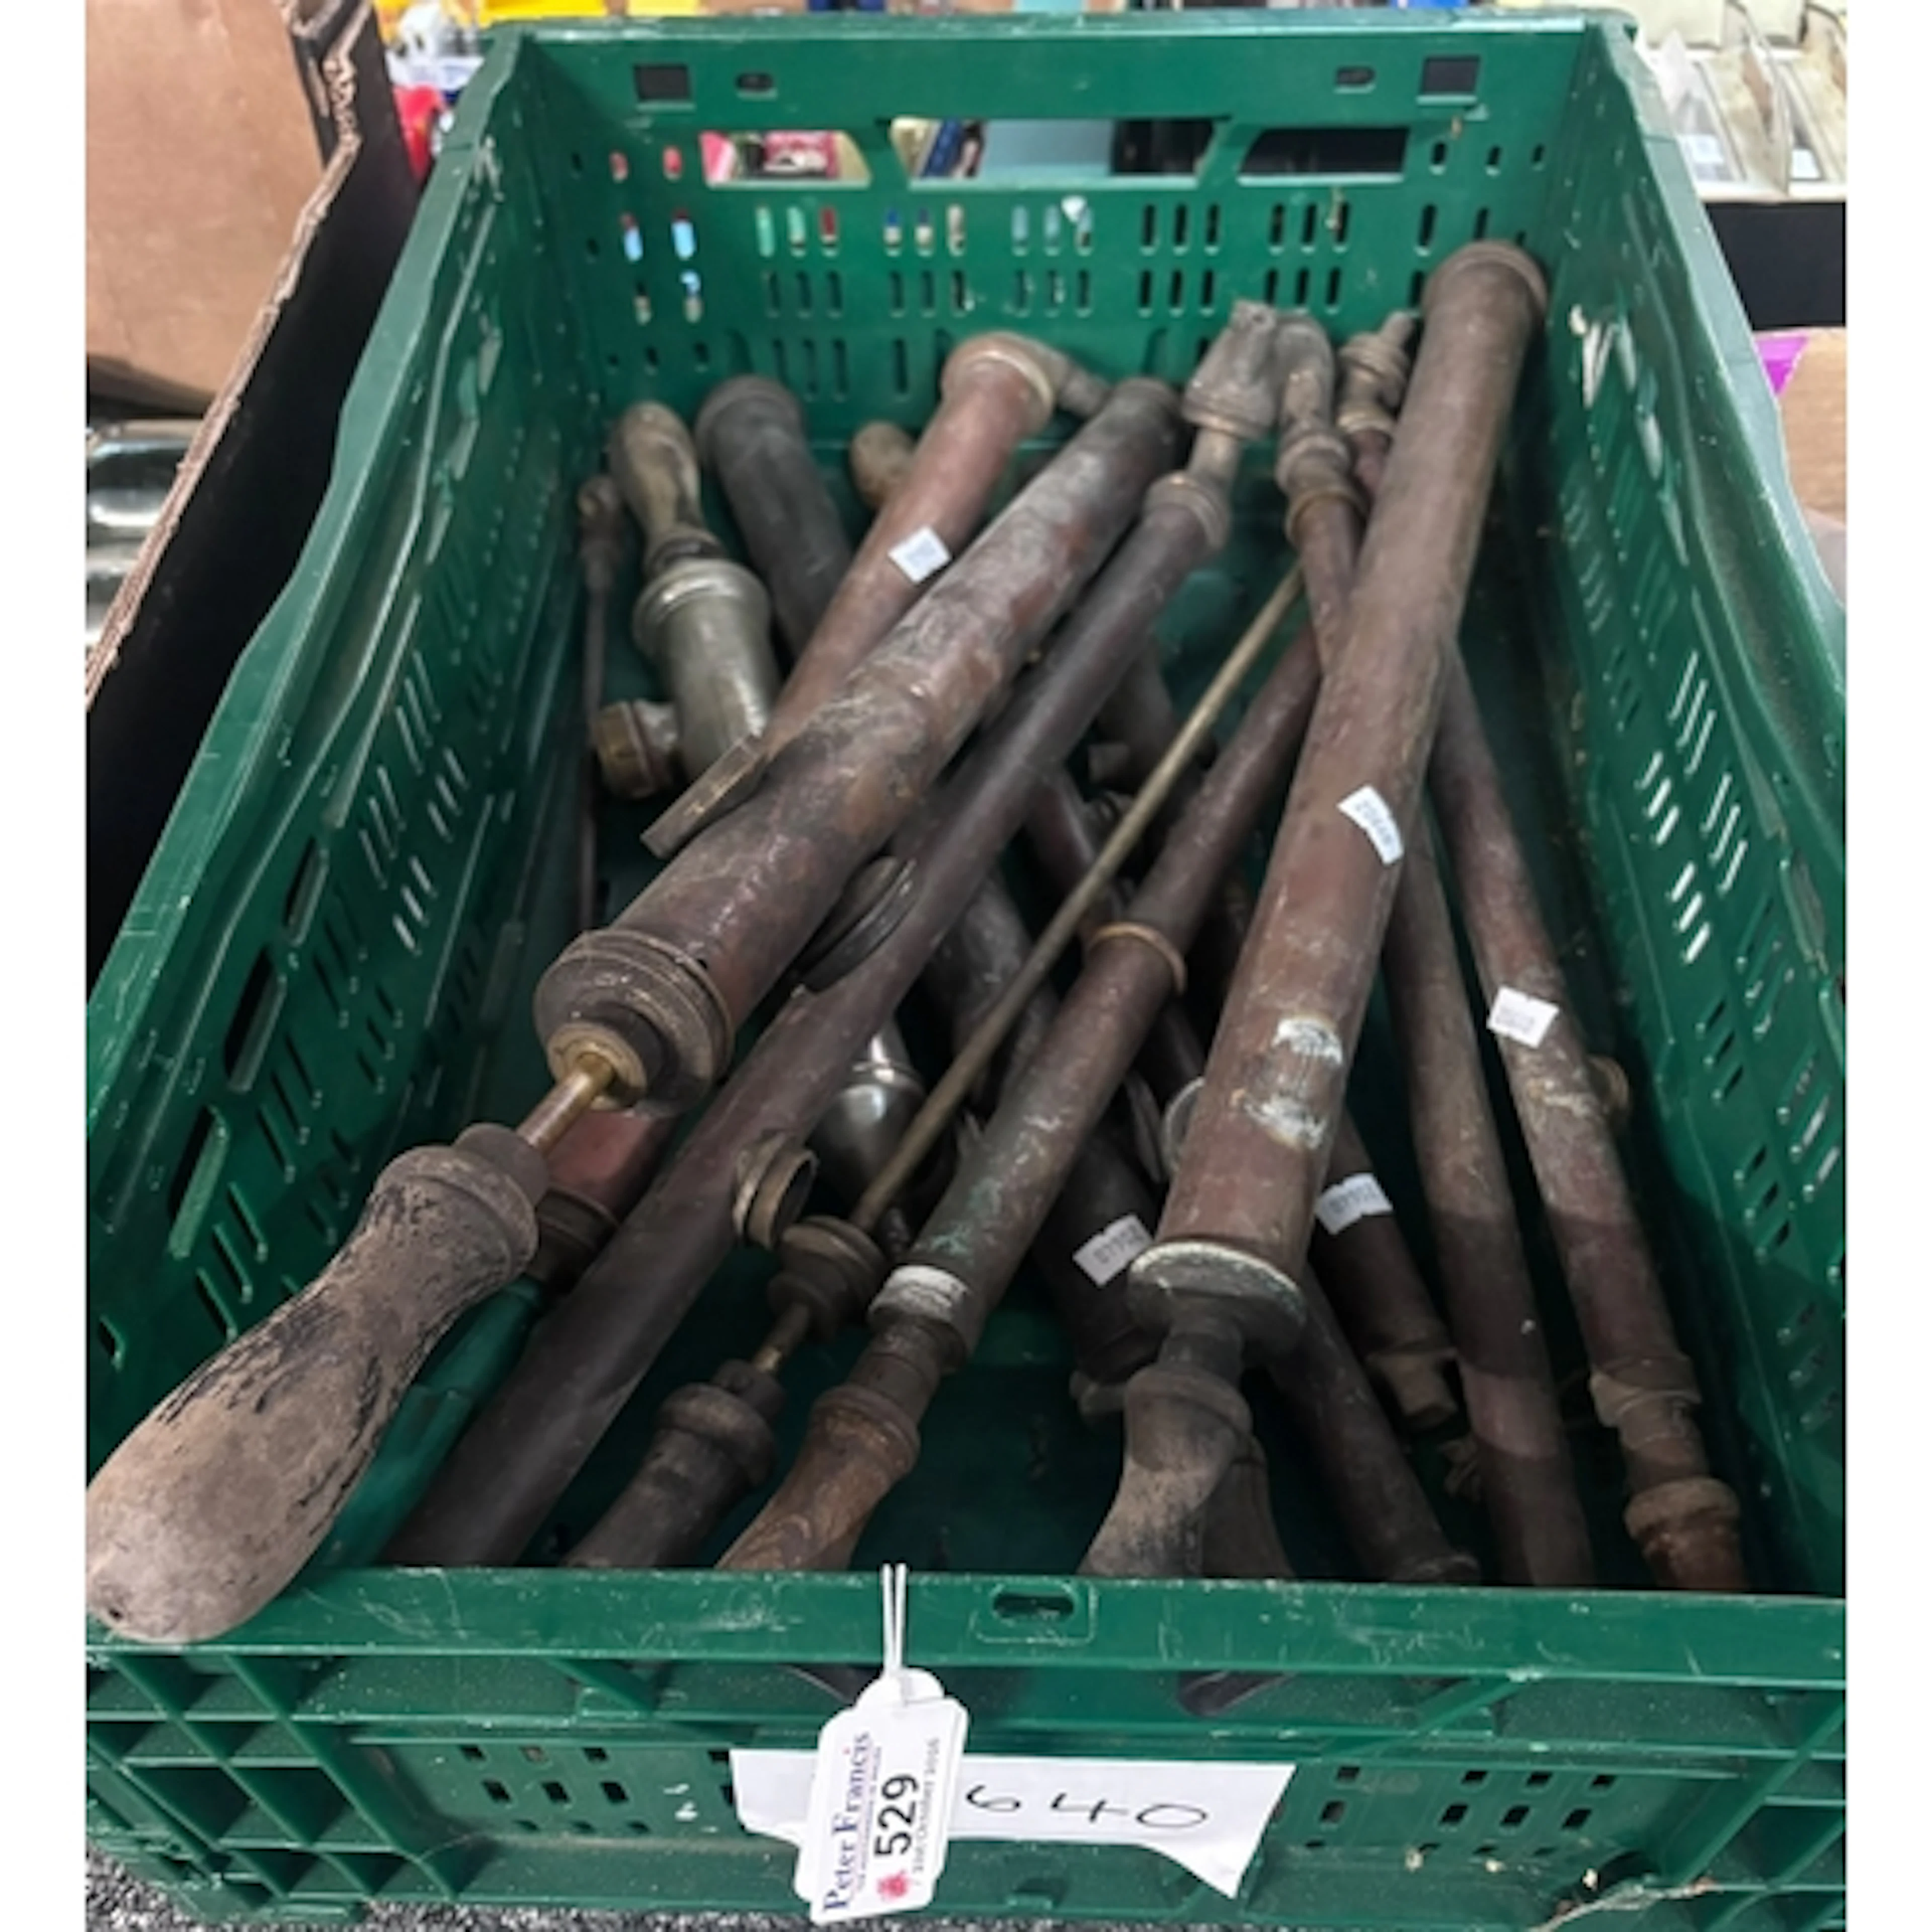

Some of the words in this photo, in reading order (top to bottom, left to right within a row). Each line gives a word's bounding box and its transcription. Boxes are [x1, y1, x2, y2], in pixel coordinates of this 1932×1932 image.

[832, 1731, 869, 1833] Francis
[874, 1773, 920, 1858] 529
[824, 1839, 855, 1911] Peter
